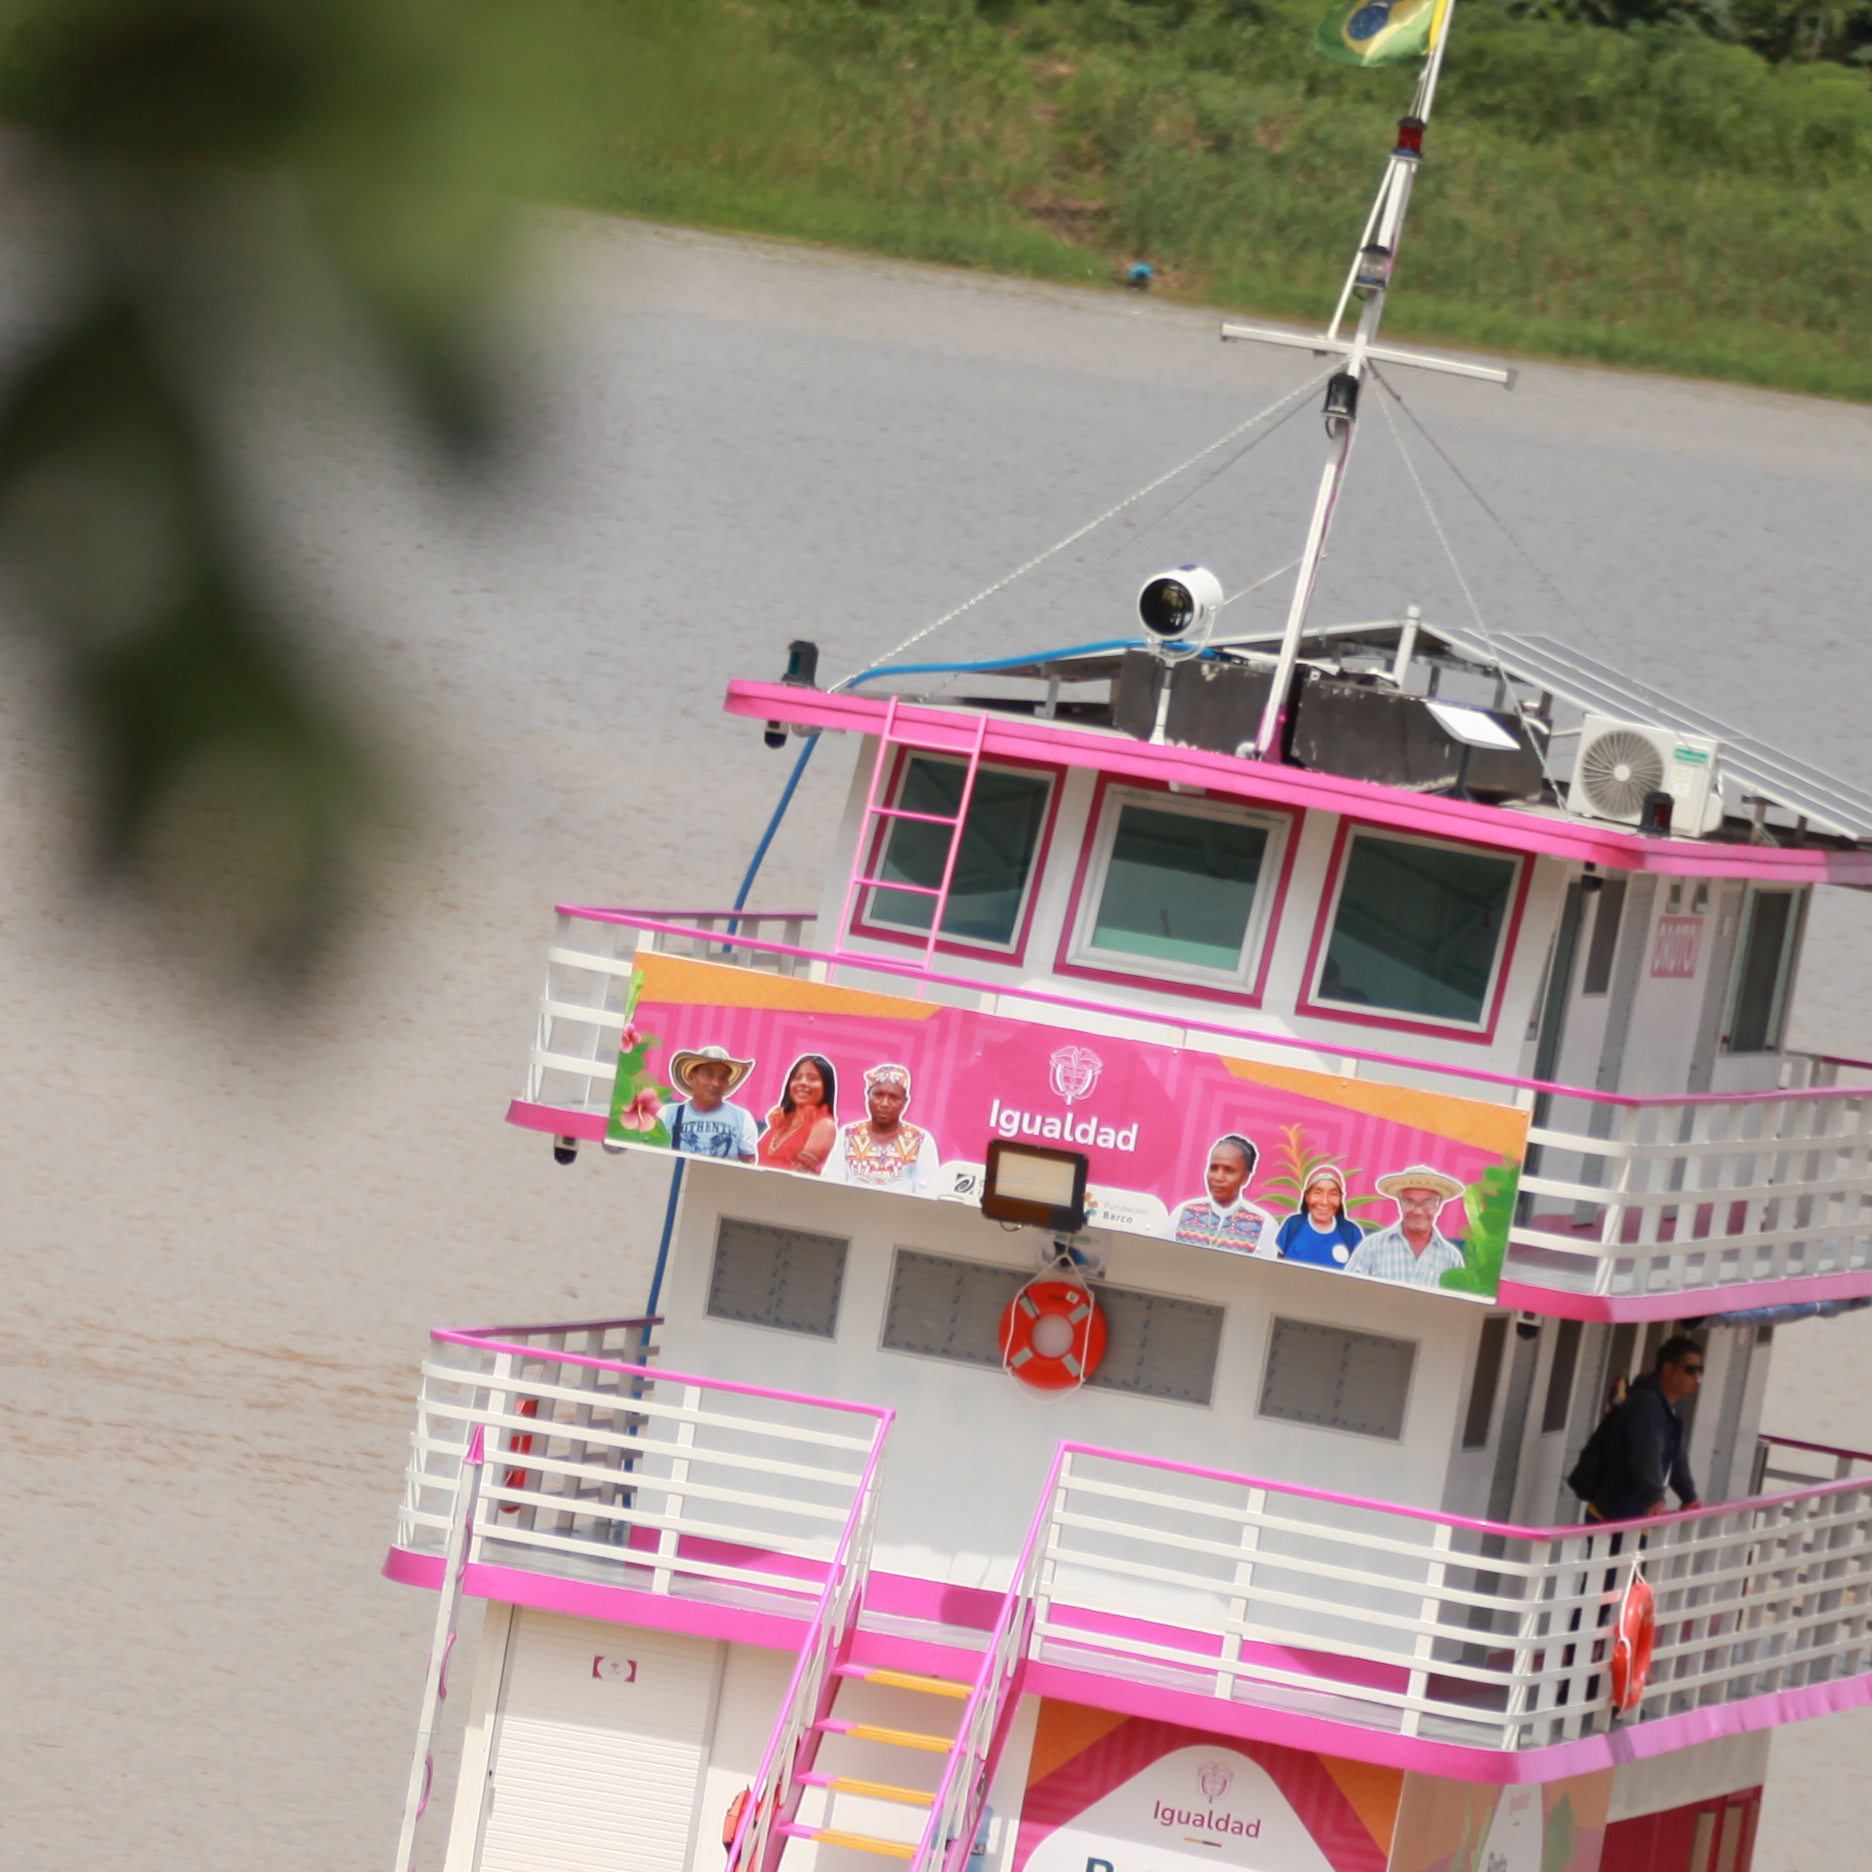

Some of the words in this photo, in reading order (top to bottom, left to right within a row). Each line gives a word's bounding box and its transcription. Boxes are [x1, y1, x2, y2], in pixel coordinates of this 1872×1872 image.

[989, 1099, 1139, 1151] Igualdad
[1102, 1211, 1133, 1224] Barco
[1153, 1800, 1261, 1838] Igualdad
